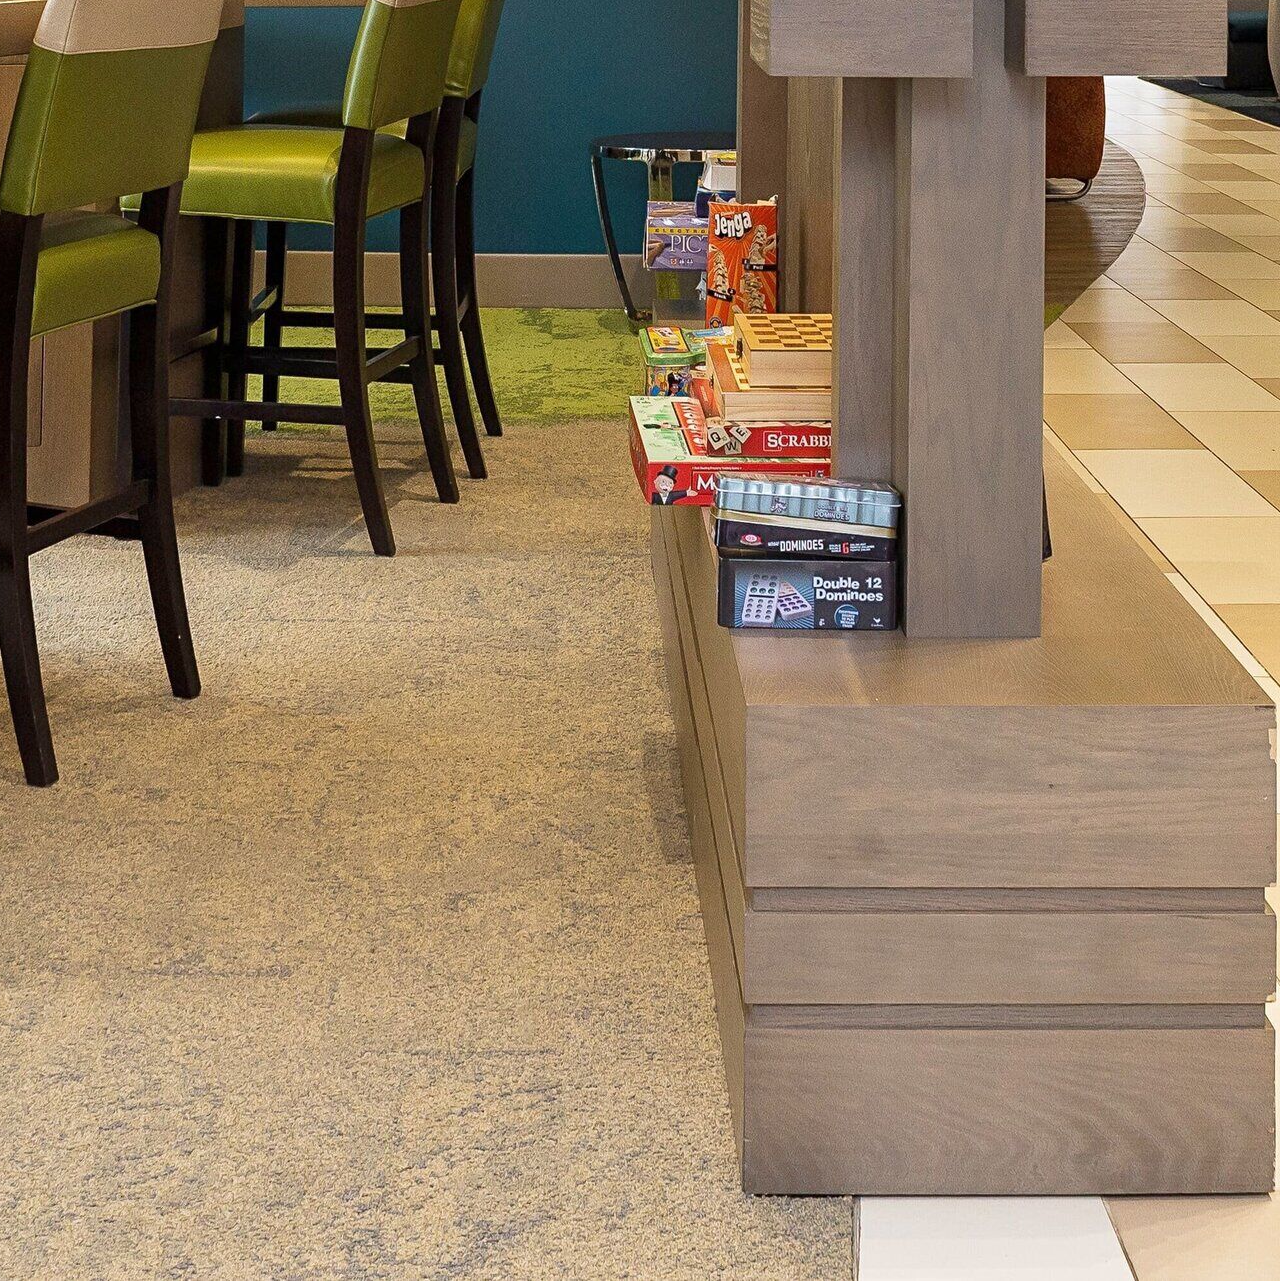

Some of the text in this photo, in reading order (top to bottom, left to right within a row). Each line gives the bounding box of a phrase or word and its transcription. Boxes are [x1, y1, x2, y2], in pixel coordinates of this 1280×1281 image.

[714, 211, 753, 238] Jenga
[710, 431, 721, 443] Q
[735, 427, 746, 437] E
[726, 441, 737, 451] W
[780, 539, 824, 552] DOMINOES
[842, 542, 850, 554] 6
[813, 576, 882, 590] Double 12
[815, 588, 884, 602] Dominoes
